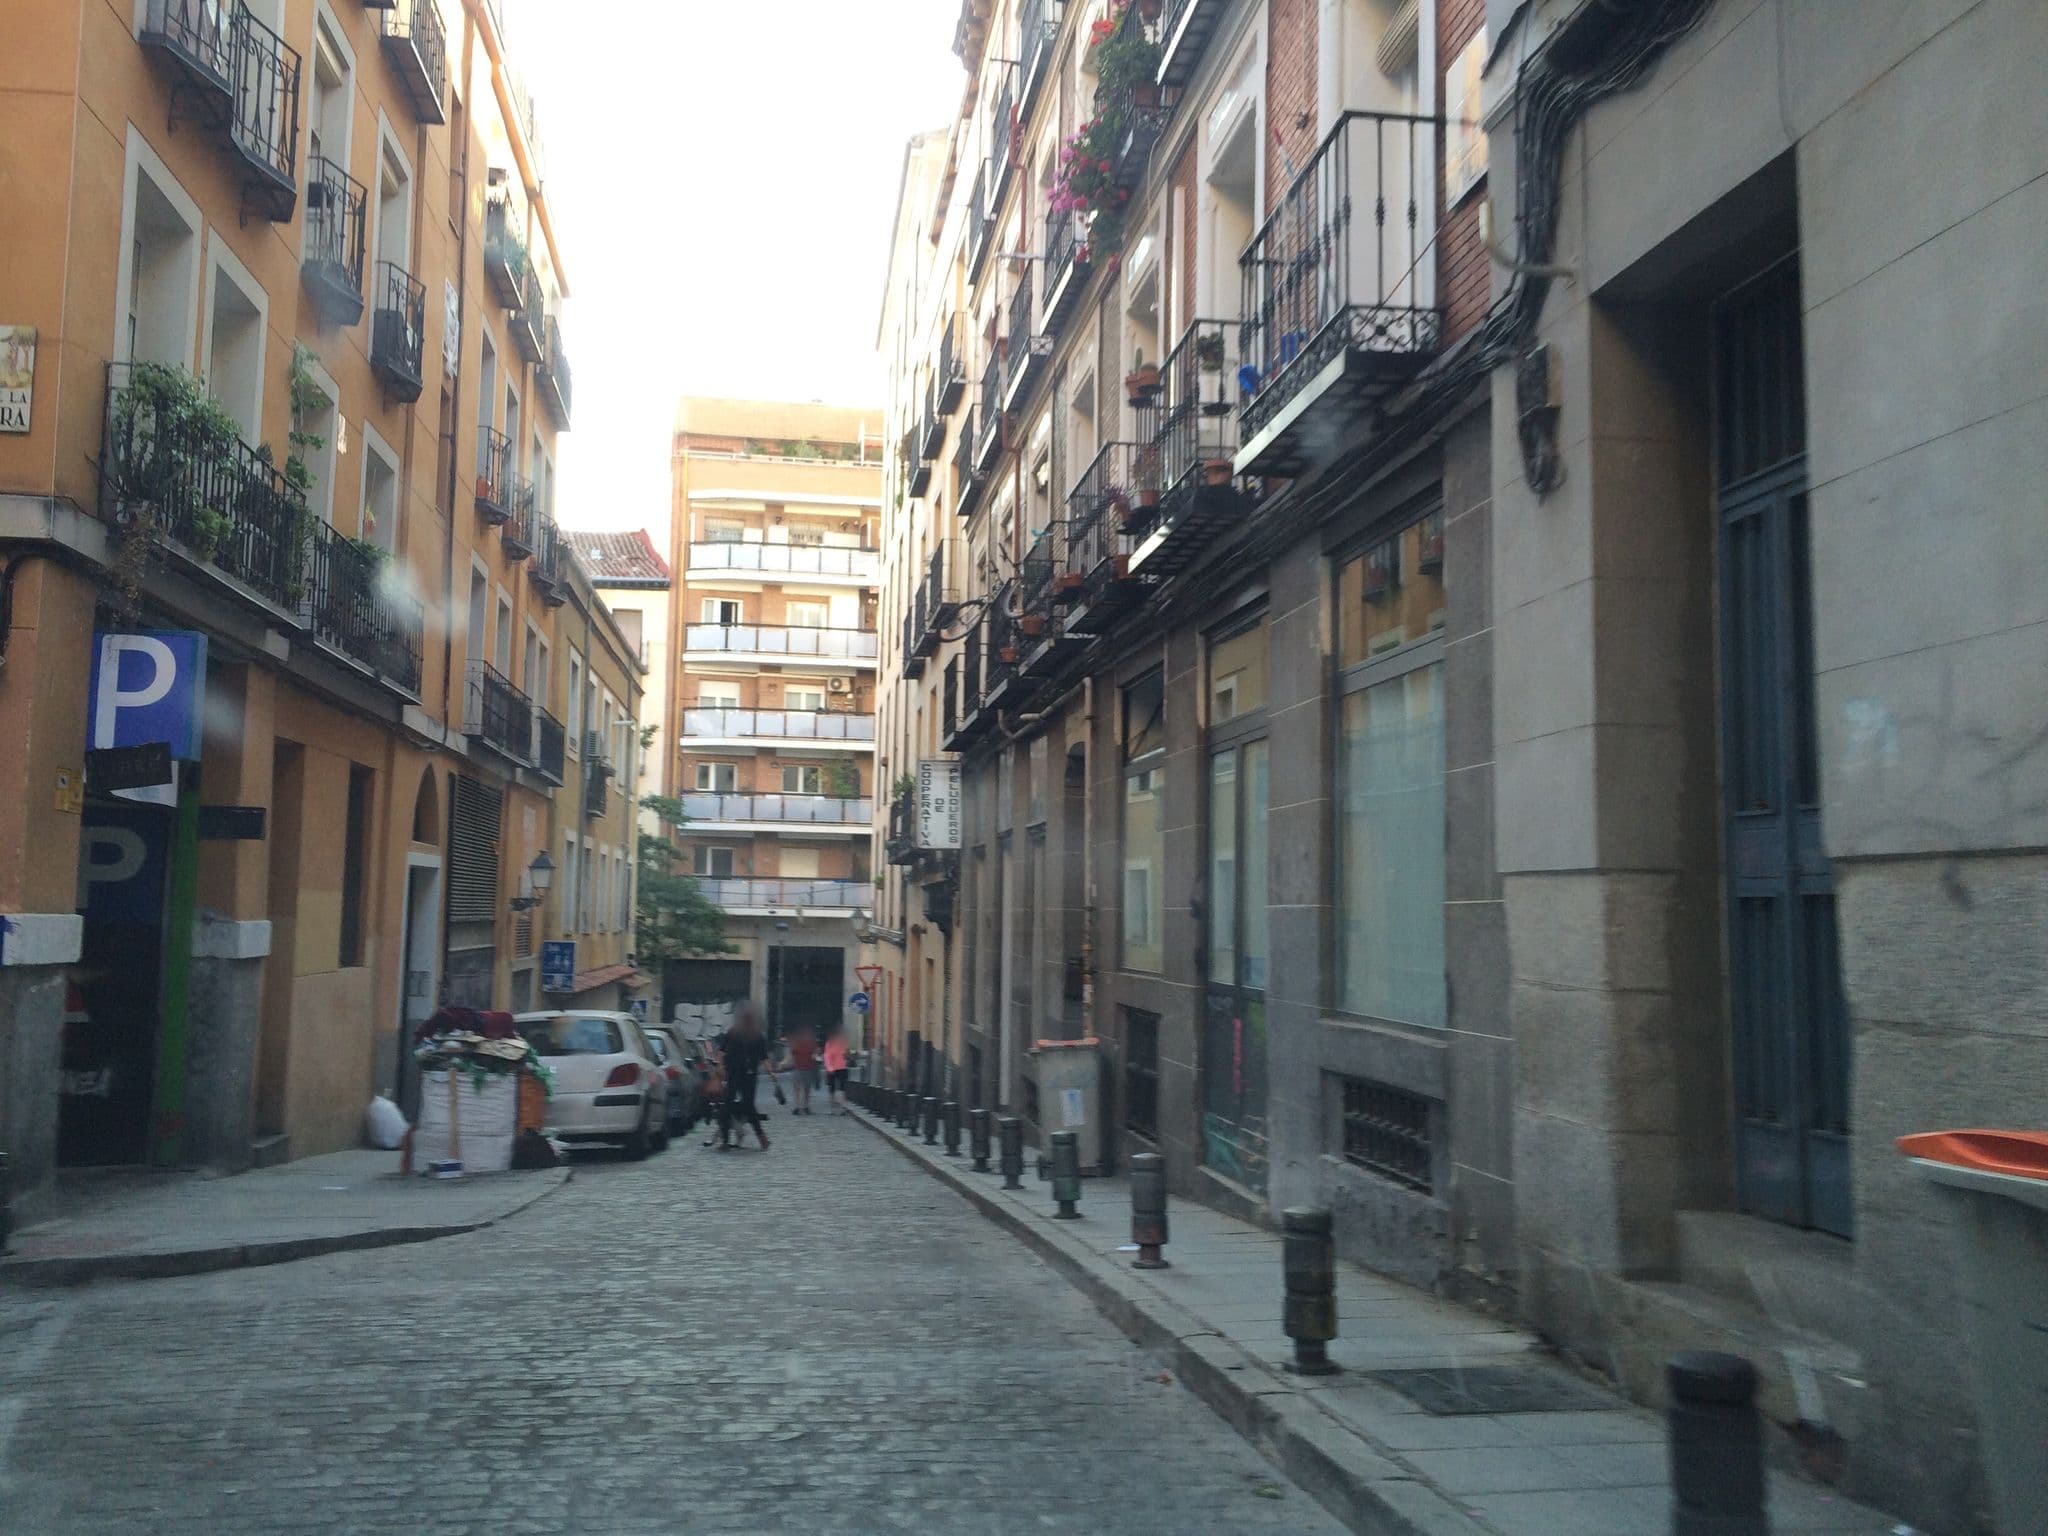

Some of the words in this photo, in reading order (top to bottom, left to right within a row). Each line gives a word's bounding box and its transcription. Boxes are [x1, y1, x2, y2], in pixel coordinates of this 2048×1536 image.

[94, 633, 177, 750] P
[920, 763, 932, 846] COOPERATIVA
[935, 798, 945, 813] DE
[78, 825, 148, 910] P
